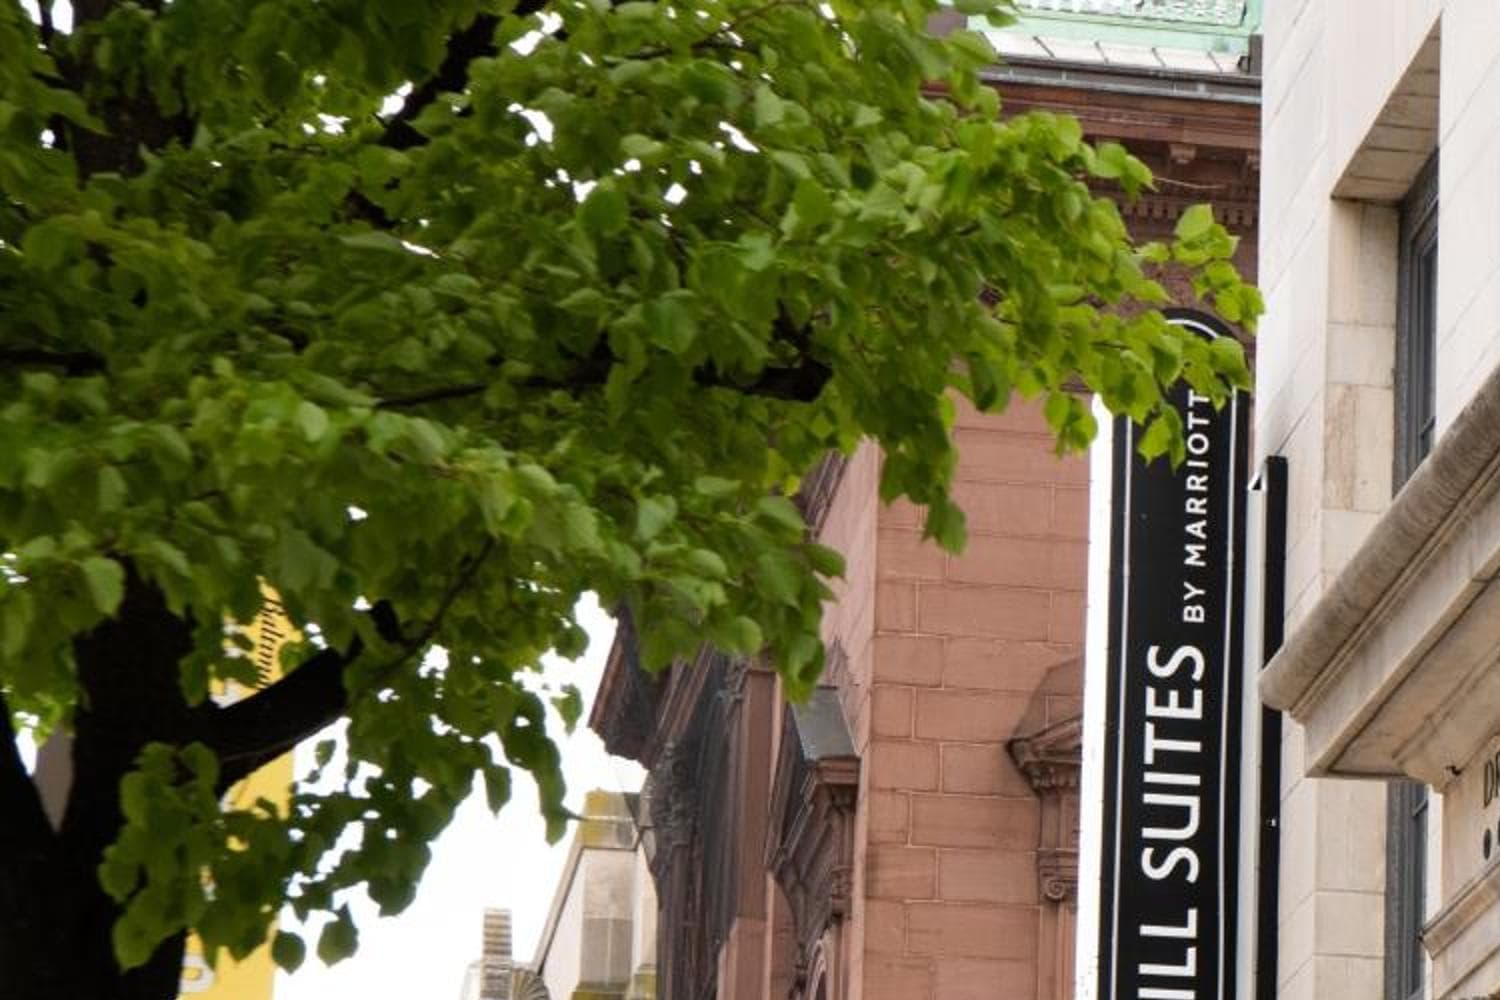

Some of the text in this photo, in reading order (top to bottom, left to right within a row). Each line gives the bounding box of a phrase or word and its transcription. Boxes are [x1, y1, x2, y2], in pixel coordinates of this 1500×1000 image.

[1184, 389, 1211, 567] MARRIOTT
[1183, 581, 1206, 622] BY
[1141, 645, 1205, 884] SUITES
